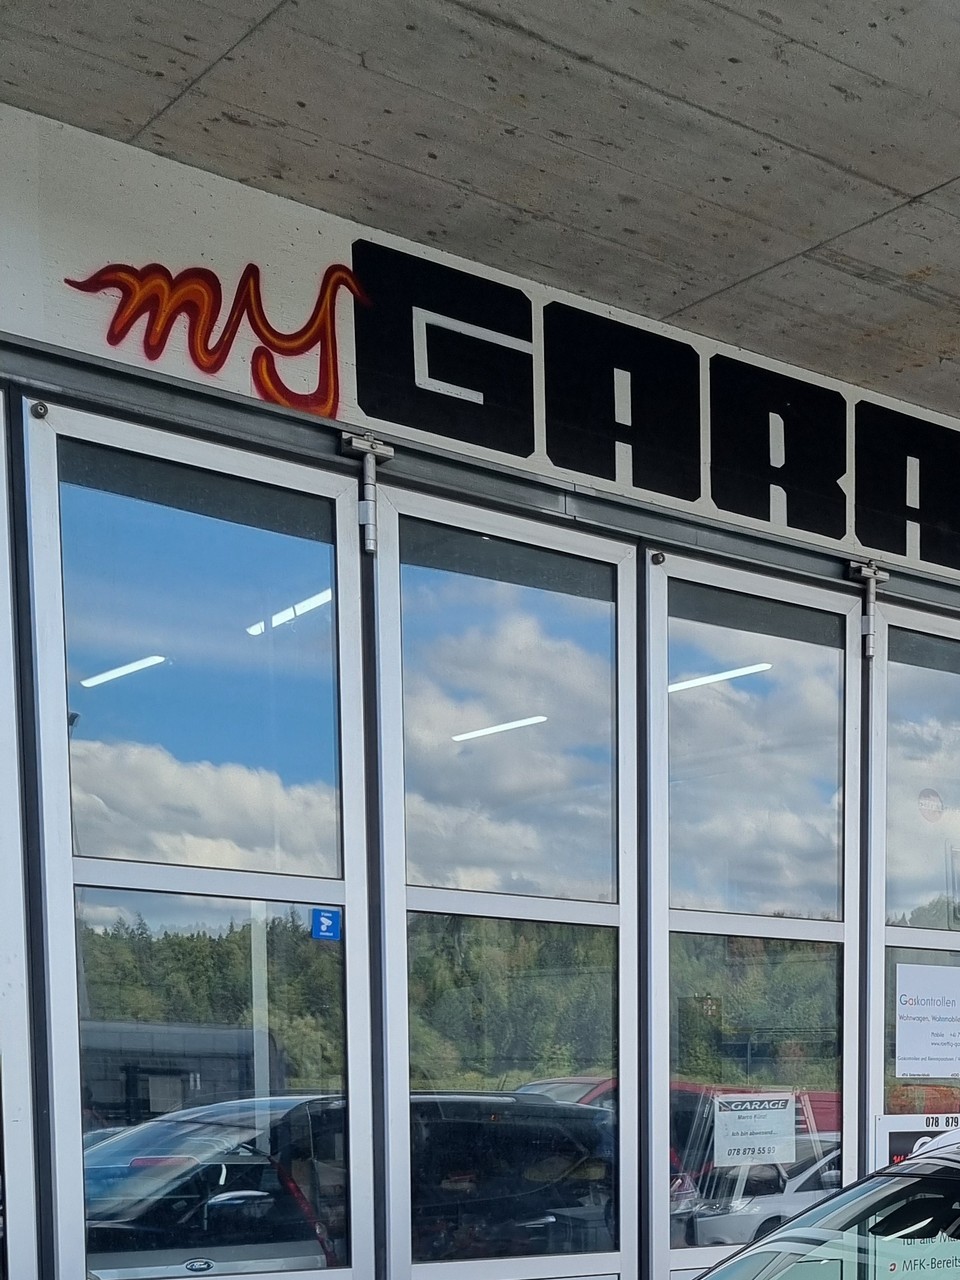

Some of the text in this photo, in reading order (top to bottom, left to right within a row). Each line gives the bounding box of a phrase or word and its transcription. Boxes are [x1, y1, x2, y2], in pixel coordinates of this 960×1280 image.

[63, 262, 372, 420] my
[899, 993, 957, 1008] Gaskontrollen
[730, 1100, 786, 1111] GARAGE
[925, 1116, 939, 1127] 078
[945, 1116, 959, 1127] 879
[727, 1148, 741, 1156] 078
[742, 1147, 756, 1156] 879
[757, 1147, 766, 1155] 55
